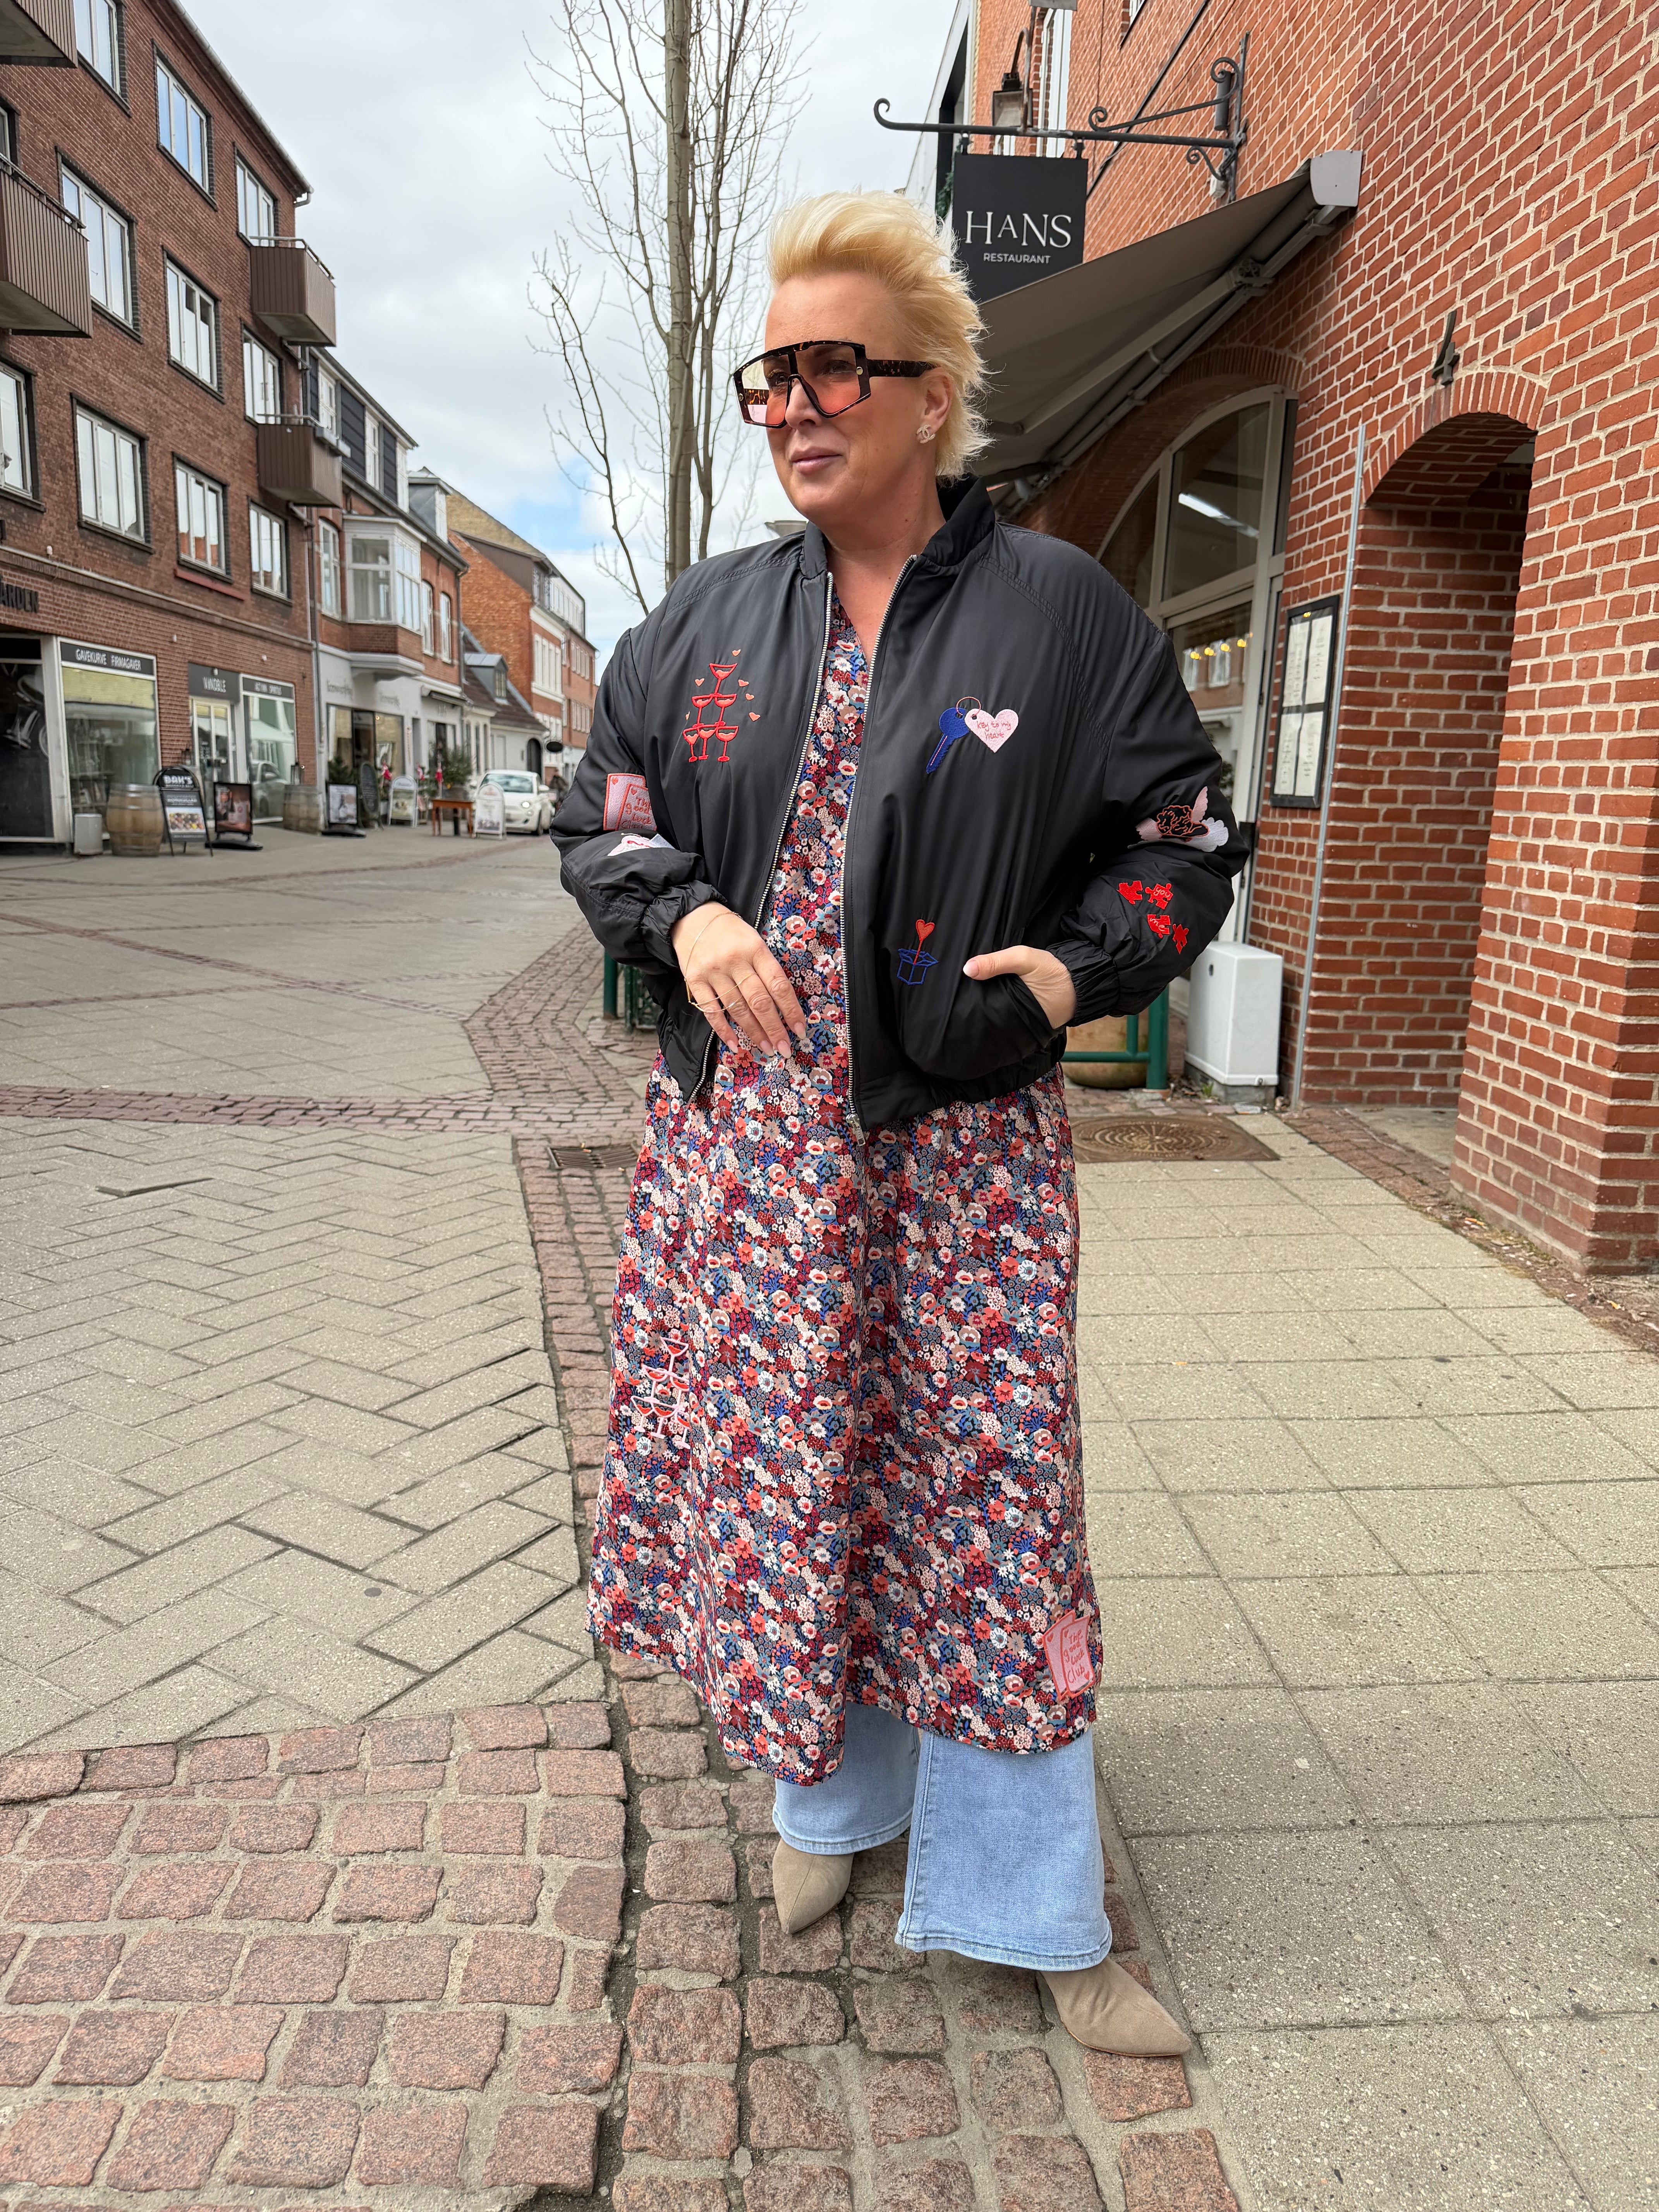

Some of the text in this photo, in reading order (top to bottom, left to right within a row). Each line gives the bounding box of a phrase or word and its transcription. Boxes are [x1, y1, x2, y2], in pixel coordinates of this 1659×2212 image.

[965, 210, 1072, 248] HANS
[983, 253, 1051, 264] RESTAURANT
[1432, 309, 1460, 386] 4
[76, 648, 107, 665] GAVEKURVE
[1001, 721, 1011, 730] my
[1069, 1629, 1083, 1644] The
